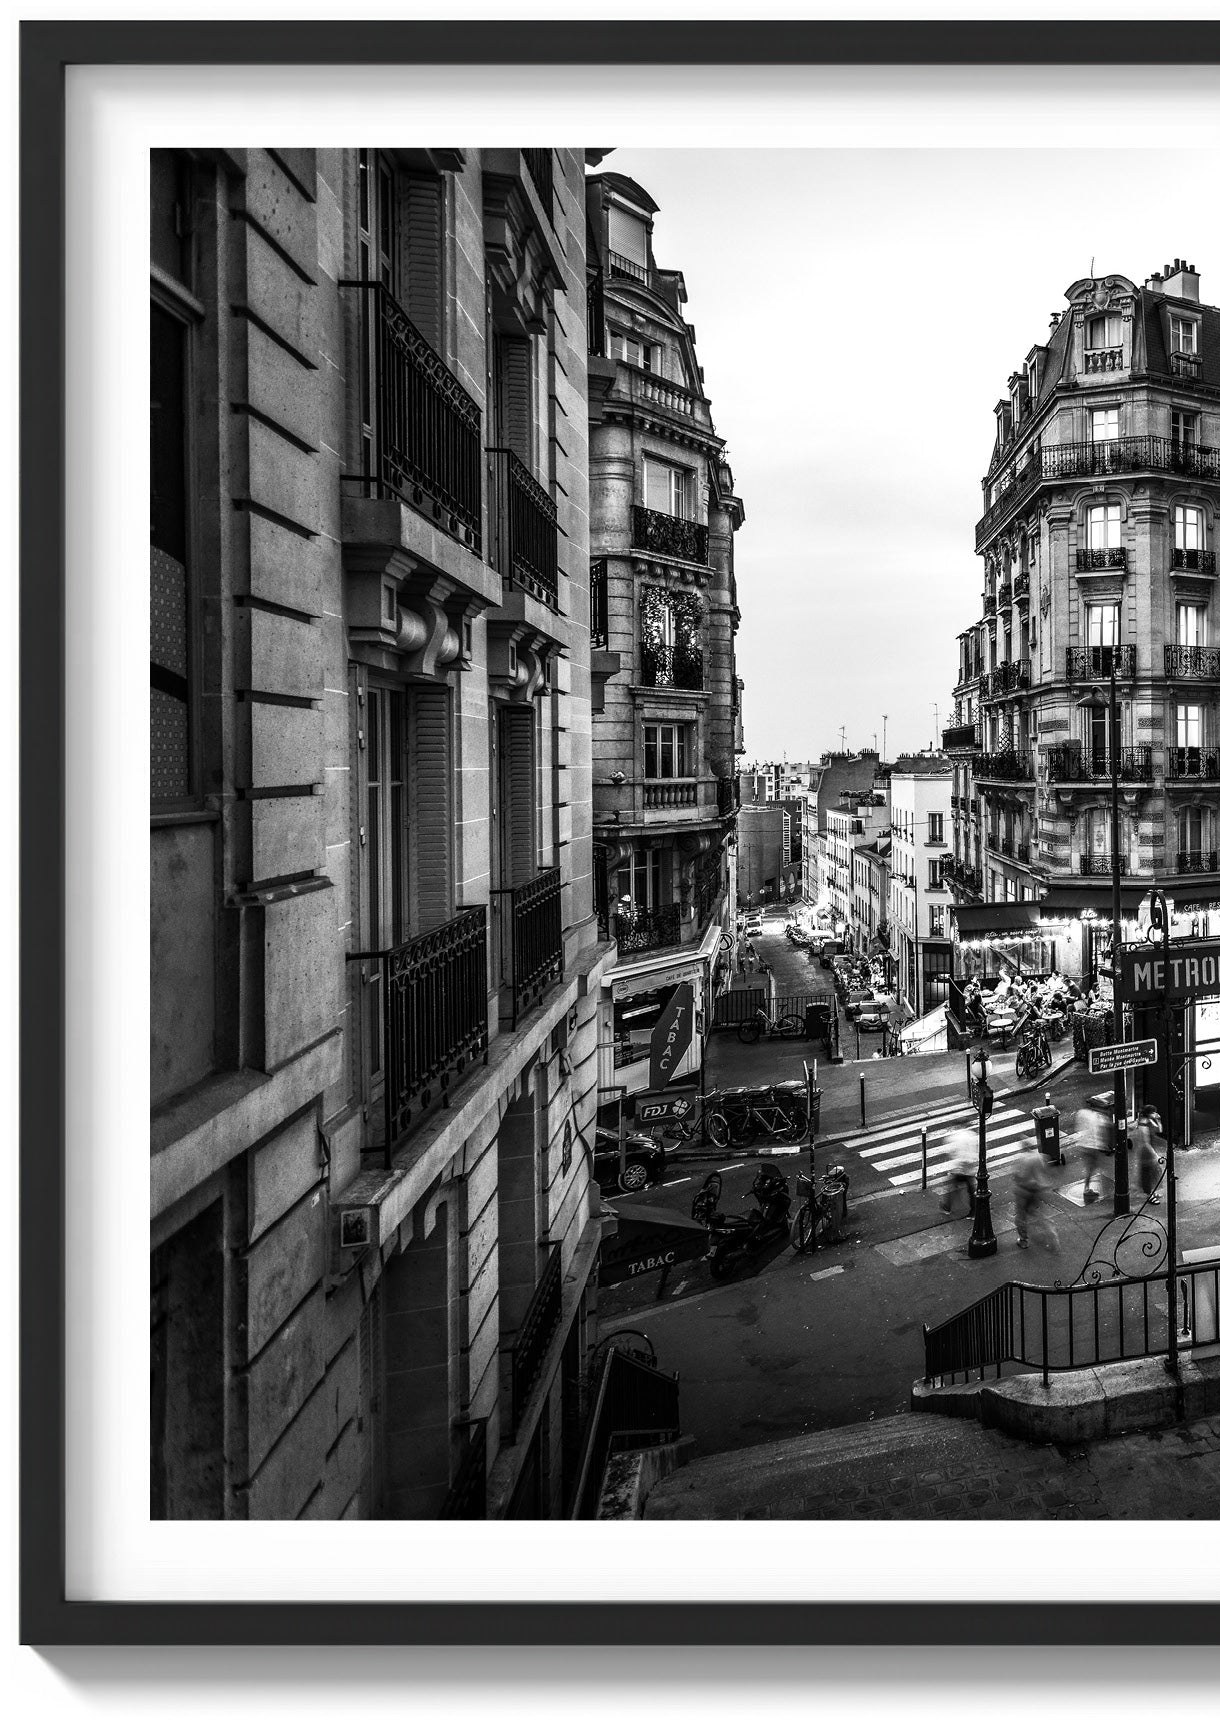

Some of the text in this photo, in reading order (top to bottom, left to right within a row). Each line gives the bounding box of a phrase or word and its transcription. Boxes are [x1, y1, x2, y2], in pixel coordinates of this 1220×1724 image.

[659, 1006, 686, 1070] TABAC
[643, 1104, 668, 1118] FDJ
[628, 1251, 675, 1275] TABAC
